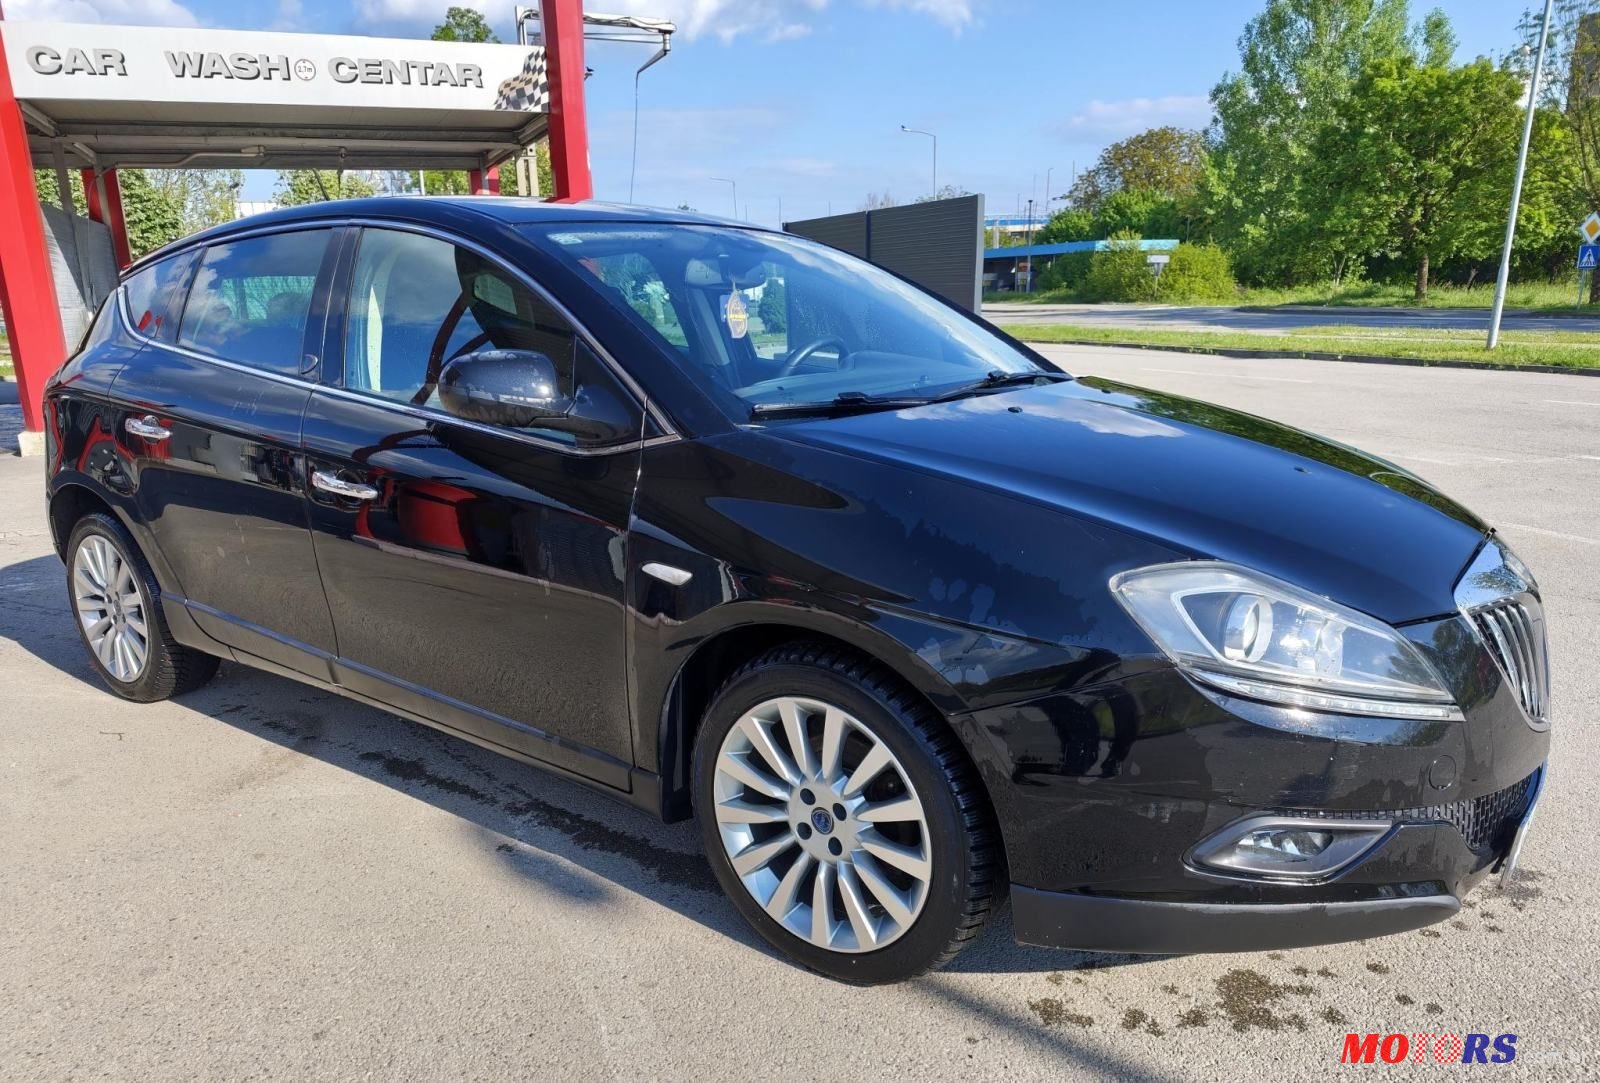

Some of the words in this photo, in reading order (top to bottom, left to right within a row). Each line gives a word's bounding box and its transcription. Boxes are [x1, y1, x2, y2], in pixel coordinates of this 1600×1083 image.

[27, 46, 127, 76] CAR
[164, 51, 291, 81] WASH
[328, 57, 484, 88] CENTAR
